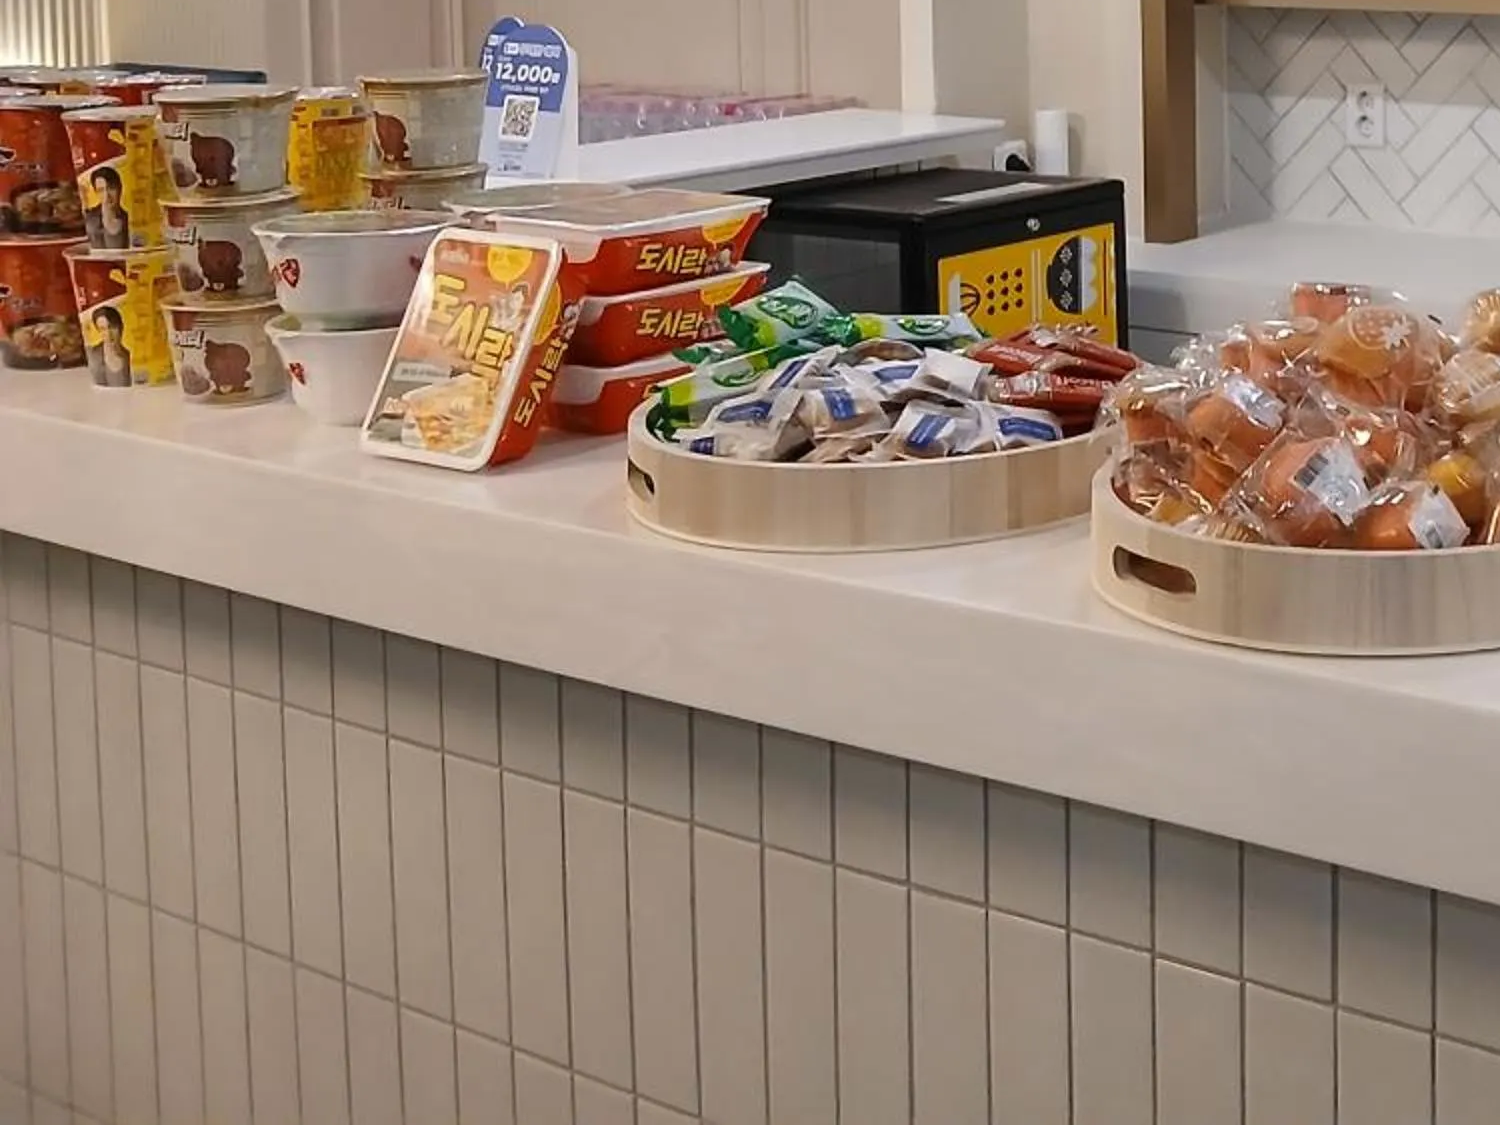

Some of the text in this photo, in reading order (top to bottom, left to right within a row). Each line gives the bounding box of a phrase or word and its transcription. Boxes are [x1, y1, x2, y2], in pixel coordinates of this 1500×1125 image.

[635, 242, 707, 275] 도시락
[426, 274, 514, 388] 도시락
[635, 307, 705, 339] 도시락
